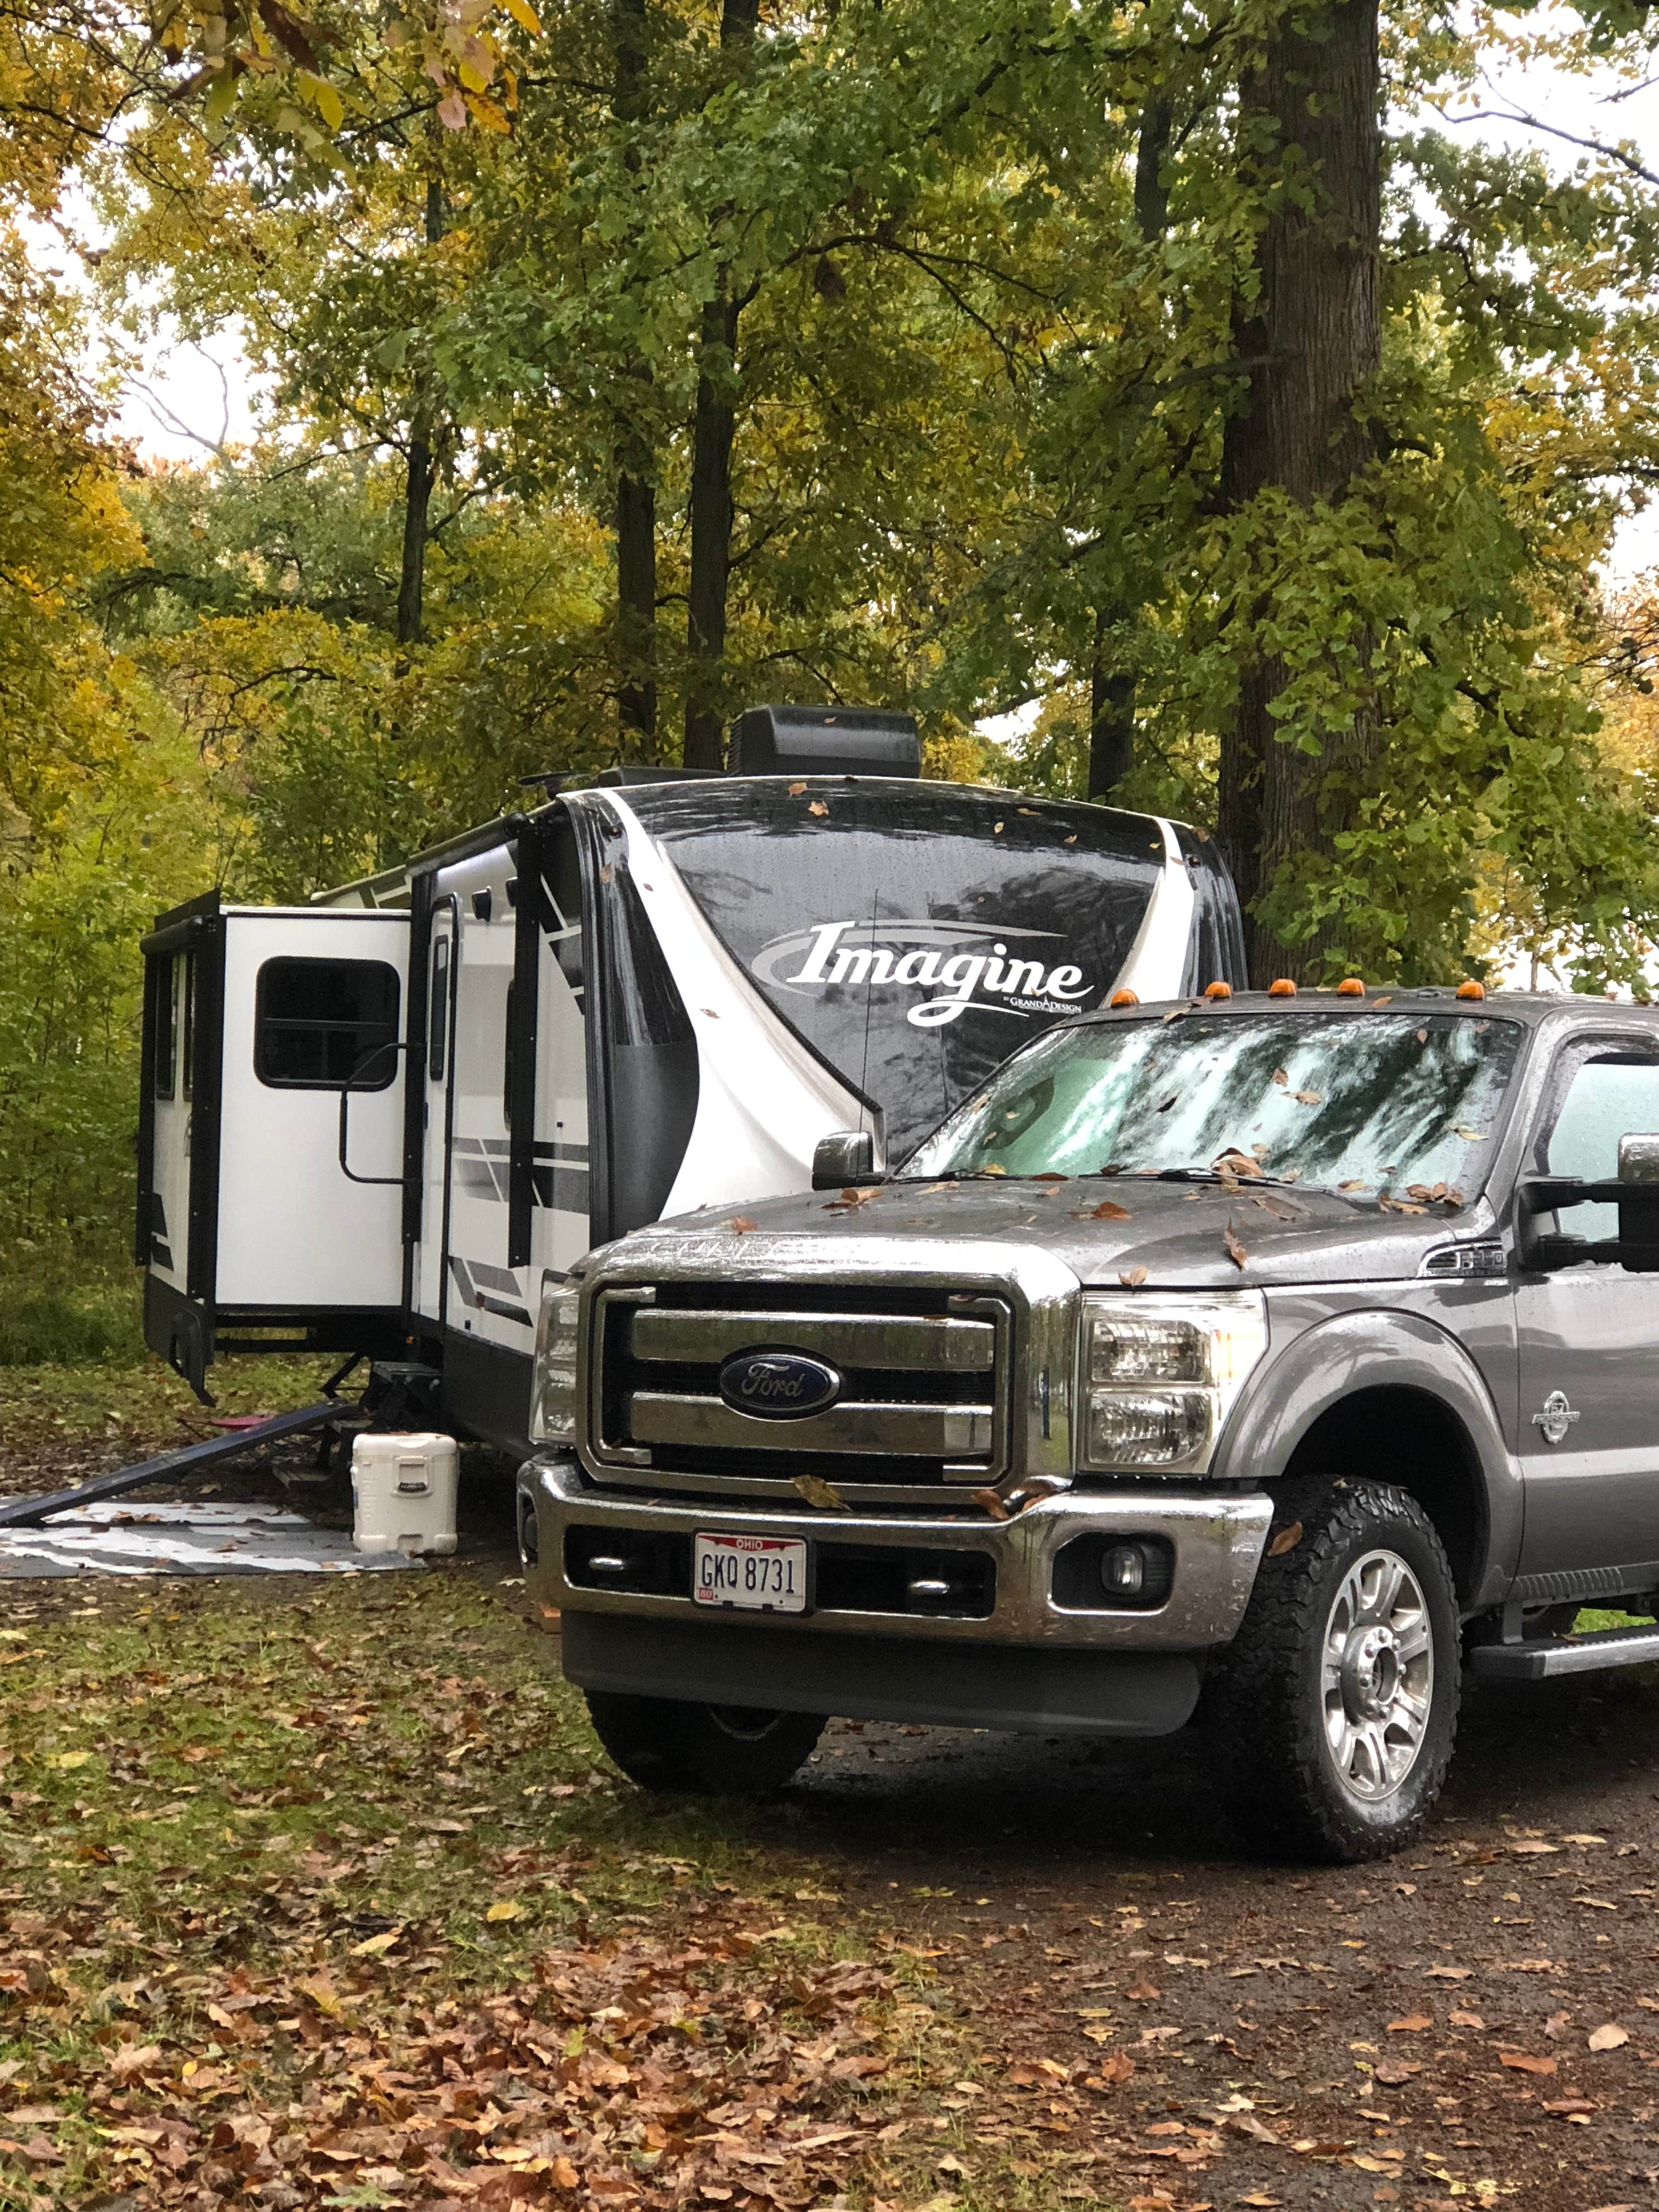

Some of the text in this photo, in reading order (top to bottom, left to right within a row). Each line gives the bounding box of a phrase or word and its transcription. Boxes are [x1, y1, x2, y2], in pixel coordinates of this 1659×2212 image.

[786, 920, 1095, 1027] Imagine
[1009, 997, 1042, 1008] GRAND
[1050, 1001, 1081, 1013] DESIGN
[741, 1362, 805, 1397] Ford
[736, 1539, 764, 1550] OHIO
[702, 1554, 794, 1594] GKQ 8731
